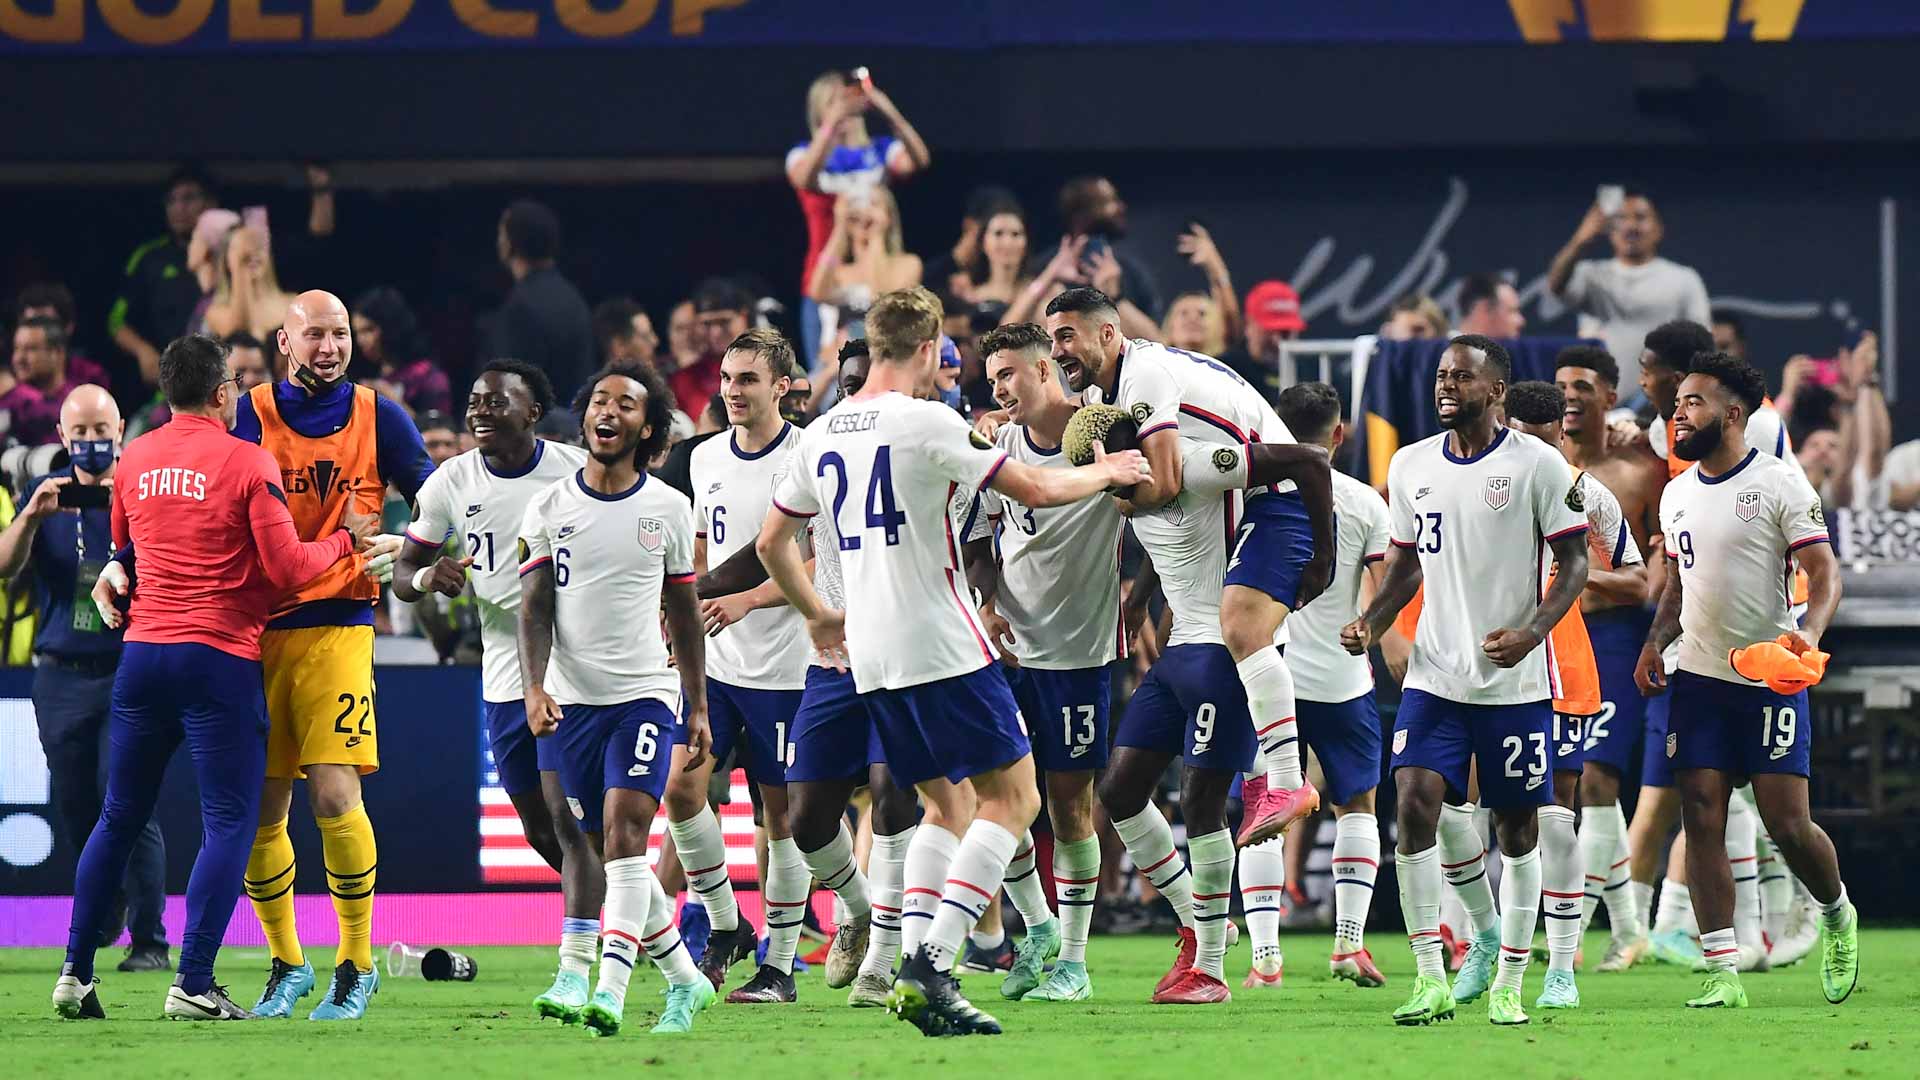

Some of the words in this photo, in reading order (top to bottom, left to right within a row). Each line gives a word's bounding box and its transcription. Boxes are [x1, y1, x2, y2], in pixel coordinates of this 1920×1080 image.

[826, 410, 880, 434] KESSLER
[138, 467, 207, 501] STATES
[817, 445, 906, 551] 24
[1489, 479, 1508, 491] USA
[1739, 494, 1758, 505] USA
[641, 520, 661, 533] USA
[1415, 512, 1442, 554] 23
[467, 532, 494, 571] 21
[556, 548, 571, 587] 6
[335, 693, 371, 736] 22
[1061, 704, 1095, 745] 13
[1194, 702, 1216, 743] 9
[1762, 706, 1796, 747] 19
[634, 722, 659, 762] 6
[1502, 732, 1548, 777] 23
[1336, 867, 1356, 875] USA
[1255, 895, 1273, 903] USA
